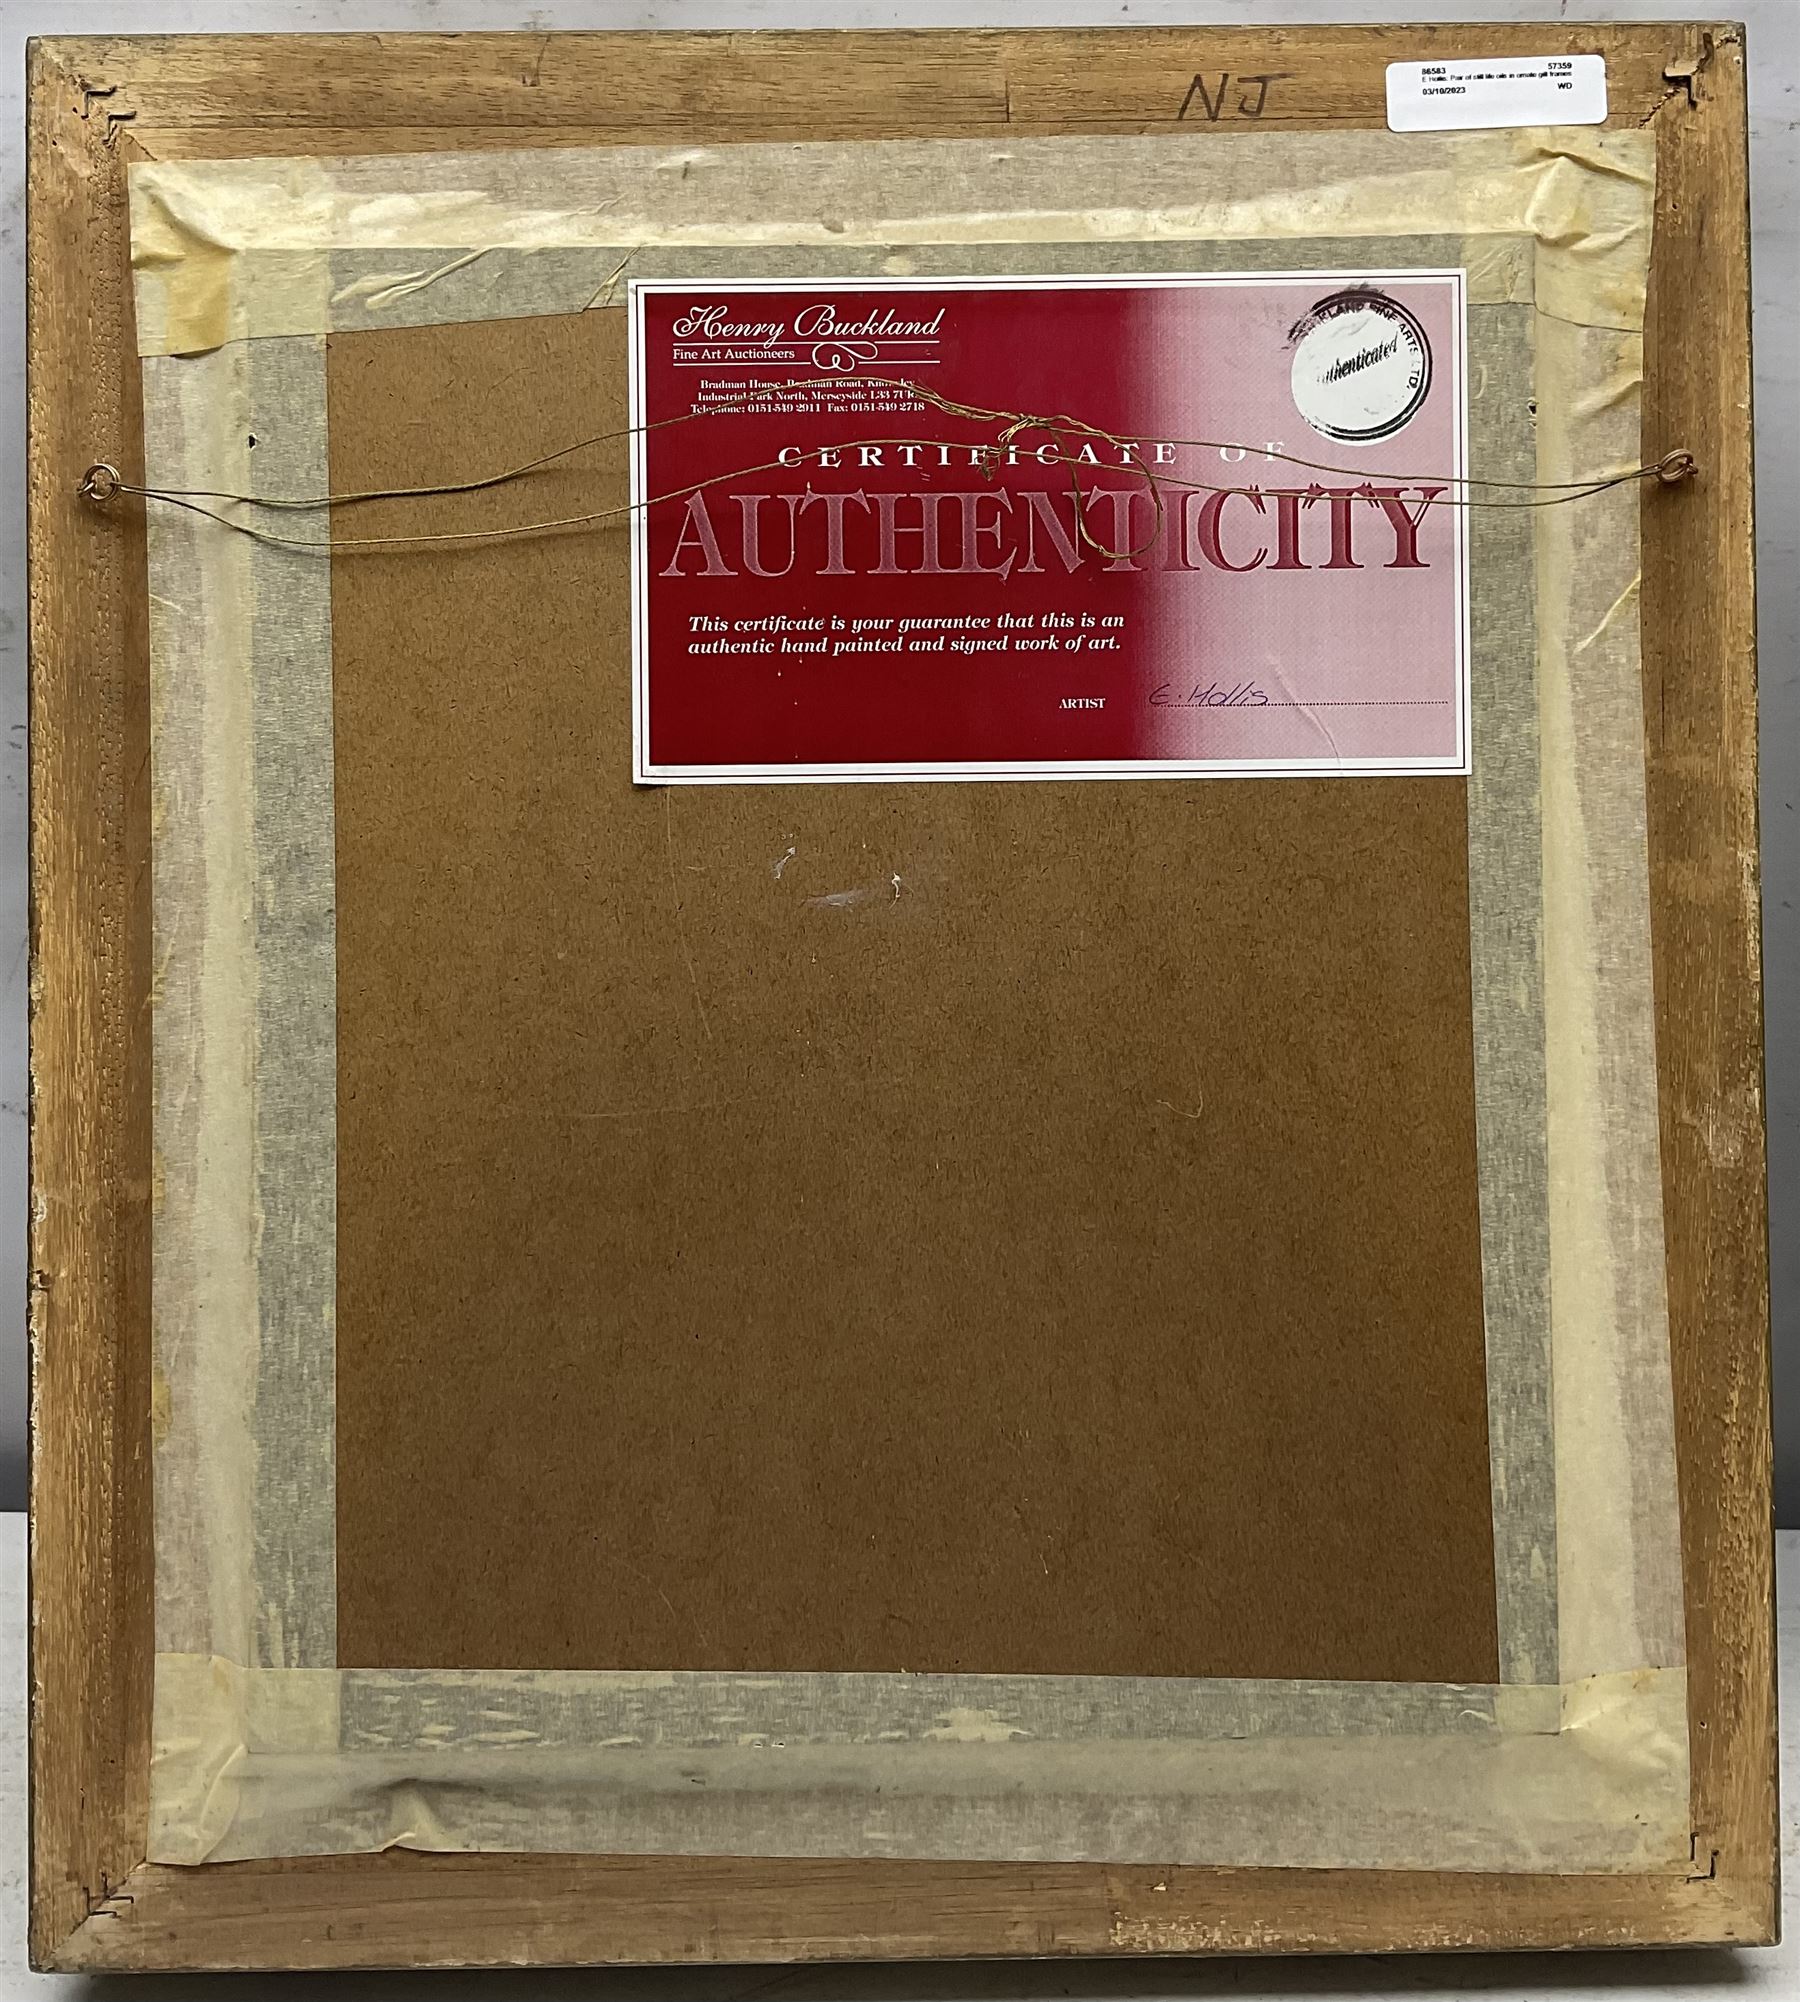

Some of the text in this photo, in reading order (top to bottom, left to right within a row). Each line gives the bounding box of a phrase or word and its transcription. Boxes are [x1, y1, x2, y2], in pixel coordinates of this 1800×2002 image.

[1547, 62, 1573, 70] 57359
[1422, 86, 1467, 95] 03/10/2023
[1557, 82, 1573, 90] WD
[673, 304, 945, 349] Henry Buckland
[673, 348, 795, 360] Fine Art Auctioneers
[700, 379, 746, 389] Bradman
[698, 391, 746, 401] Industrial
[776, 391, 807, 401] North,
[811, 390, 867, 402] Merseyside
[747, 403, 793, 412] 0151-549
[795, 403, 820, 413] 2911
[827, 403, 848, 412] Fax:
[851, 402, 897, 412] 0151-549
[899, 402, 925, 411] 2718
[778, 441, 1285, 468] CERTIFICATE OF
[658, 484, 1449, 581] AUTHENTICITY
[689, 612, 1125, 634] This certificate is your guarantee that this is an
[688, 634, 1121, 656] authentic hand painted and signed work of art.
[1187, 681, 1268, 706] Hollis
[1059, 698, 1105, 709] ARTIST
